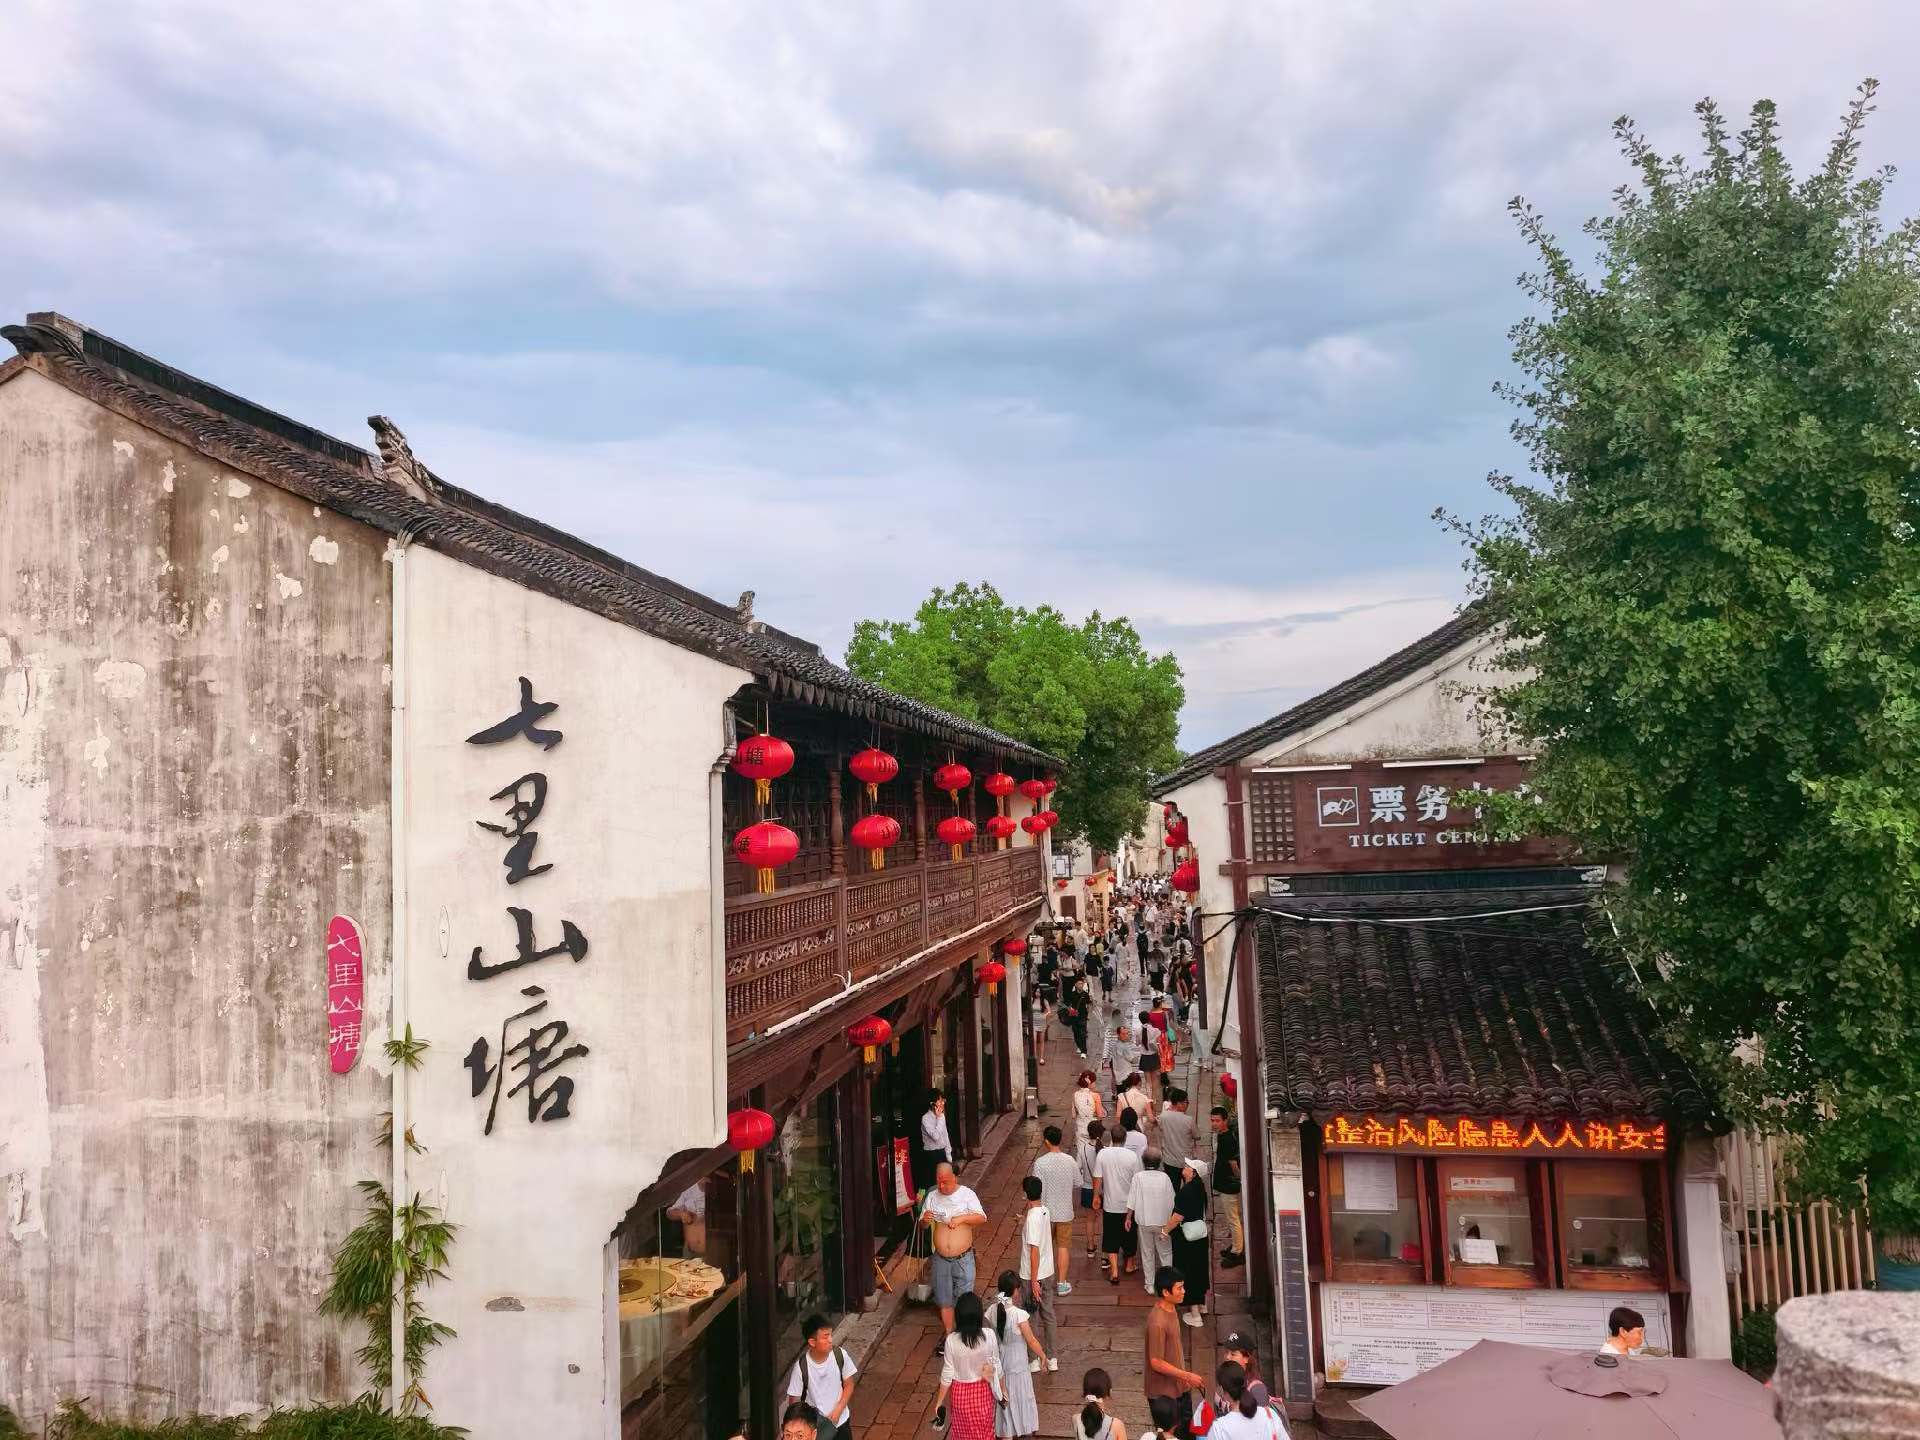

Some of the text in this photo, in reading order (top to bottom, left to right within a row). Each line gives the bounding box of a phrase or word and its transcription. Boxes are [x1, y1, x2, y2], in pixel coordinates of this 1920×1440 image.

[1349, 832, 1427, 848] TICKET
[464, 676, 589, 1136] 七里山塘
[327, 933, 363, 1057] 七里山塘
